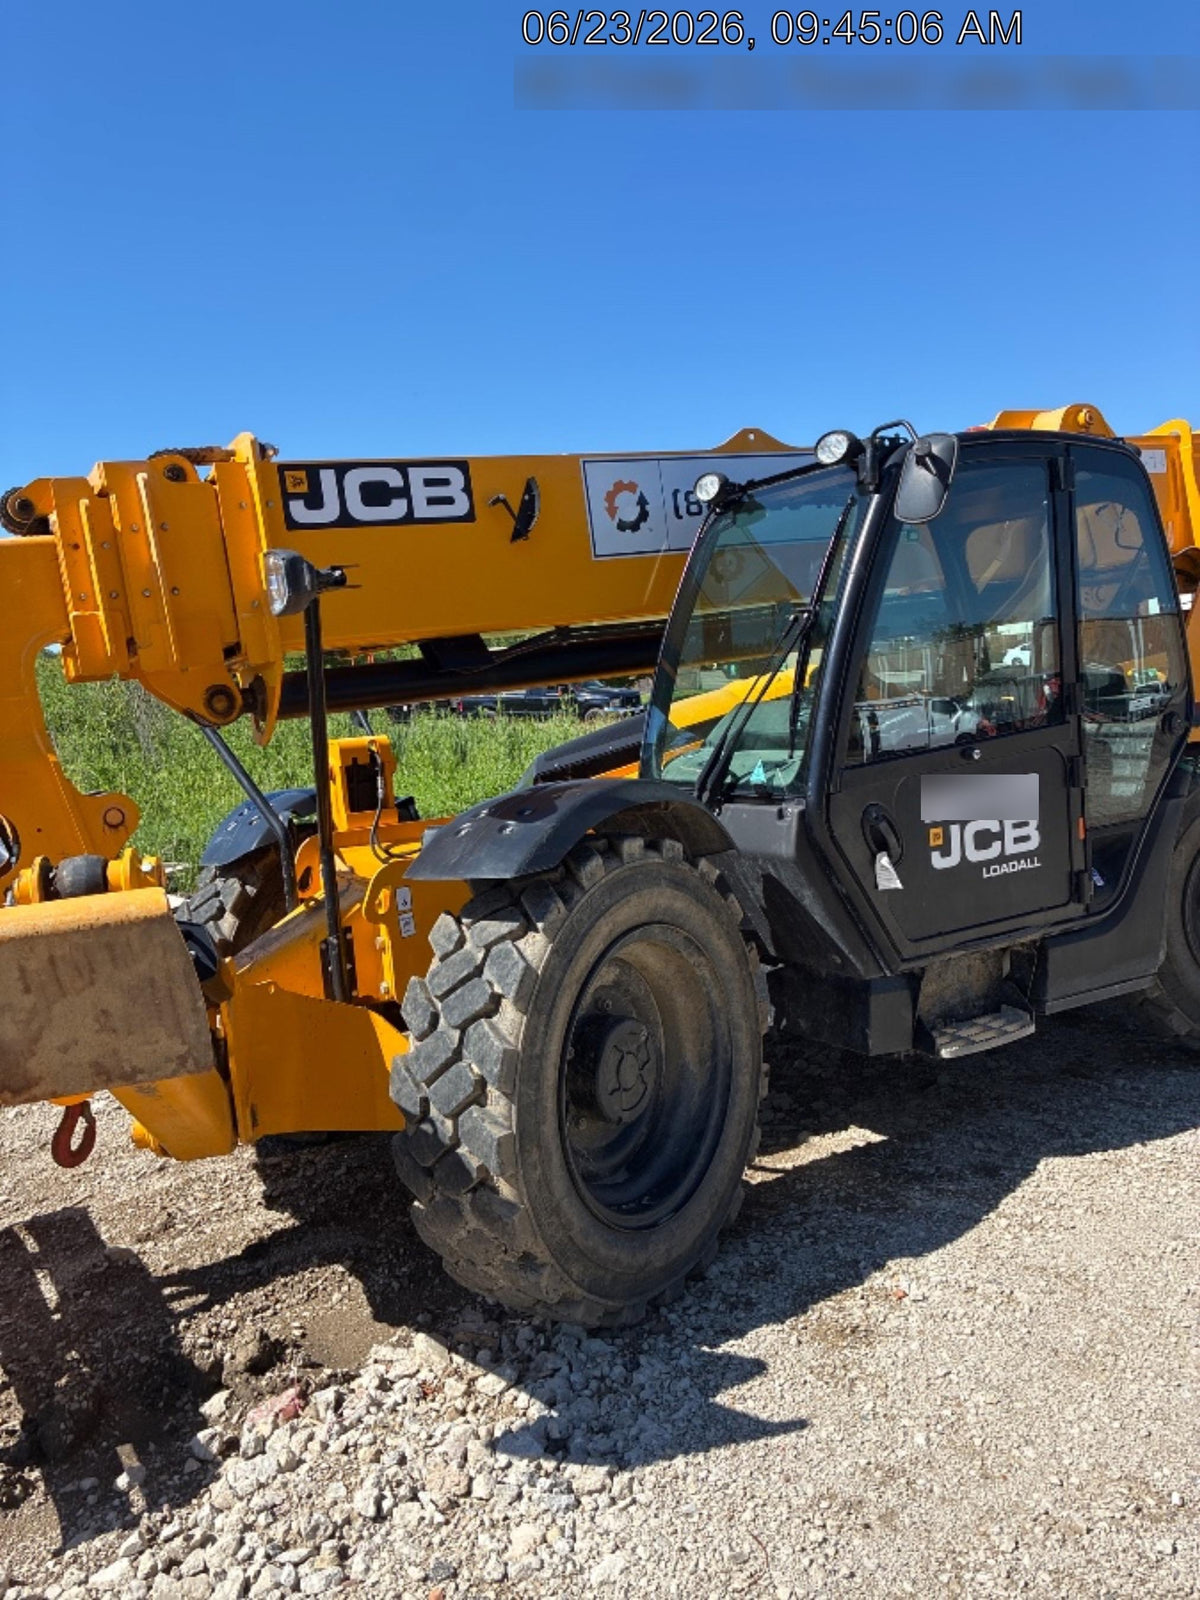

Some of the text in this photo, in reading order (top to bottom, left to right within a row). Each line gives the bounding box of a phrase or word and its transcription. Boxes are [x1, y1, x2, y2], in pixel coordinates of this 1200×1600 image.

[289, 466, 470, 523] JCB
[931, 820, 1040, 869] JCB
[983, 857, 1041, 878] LOADALL
